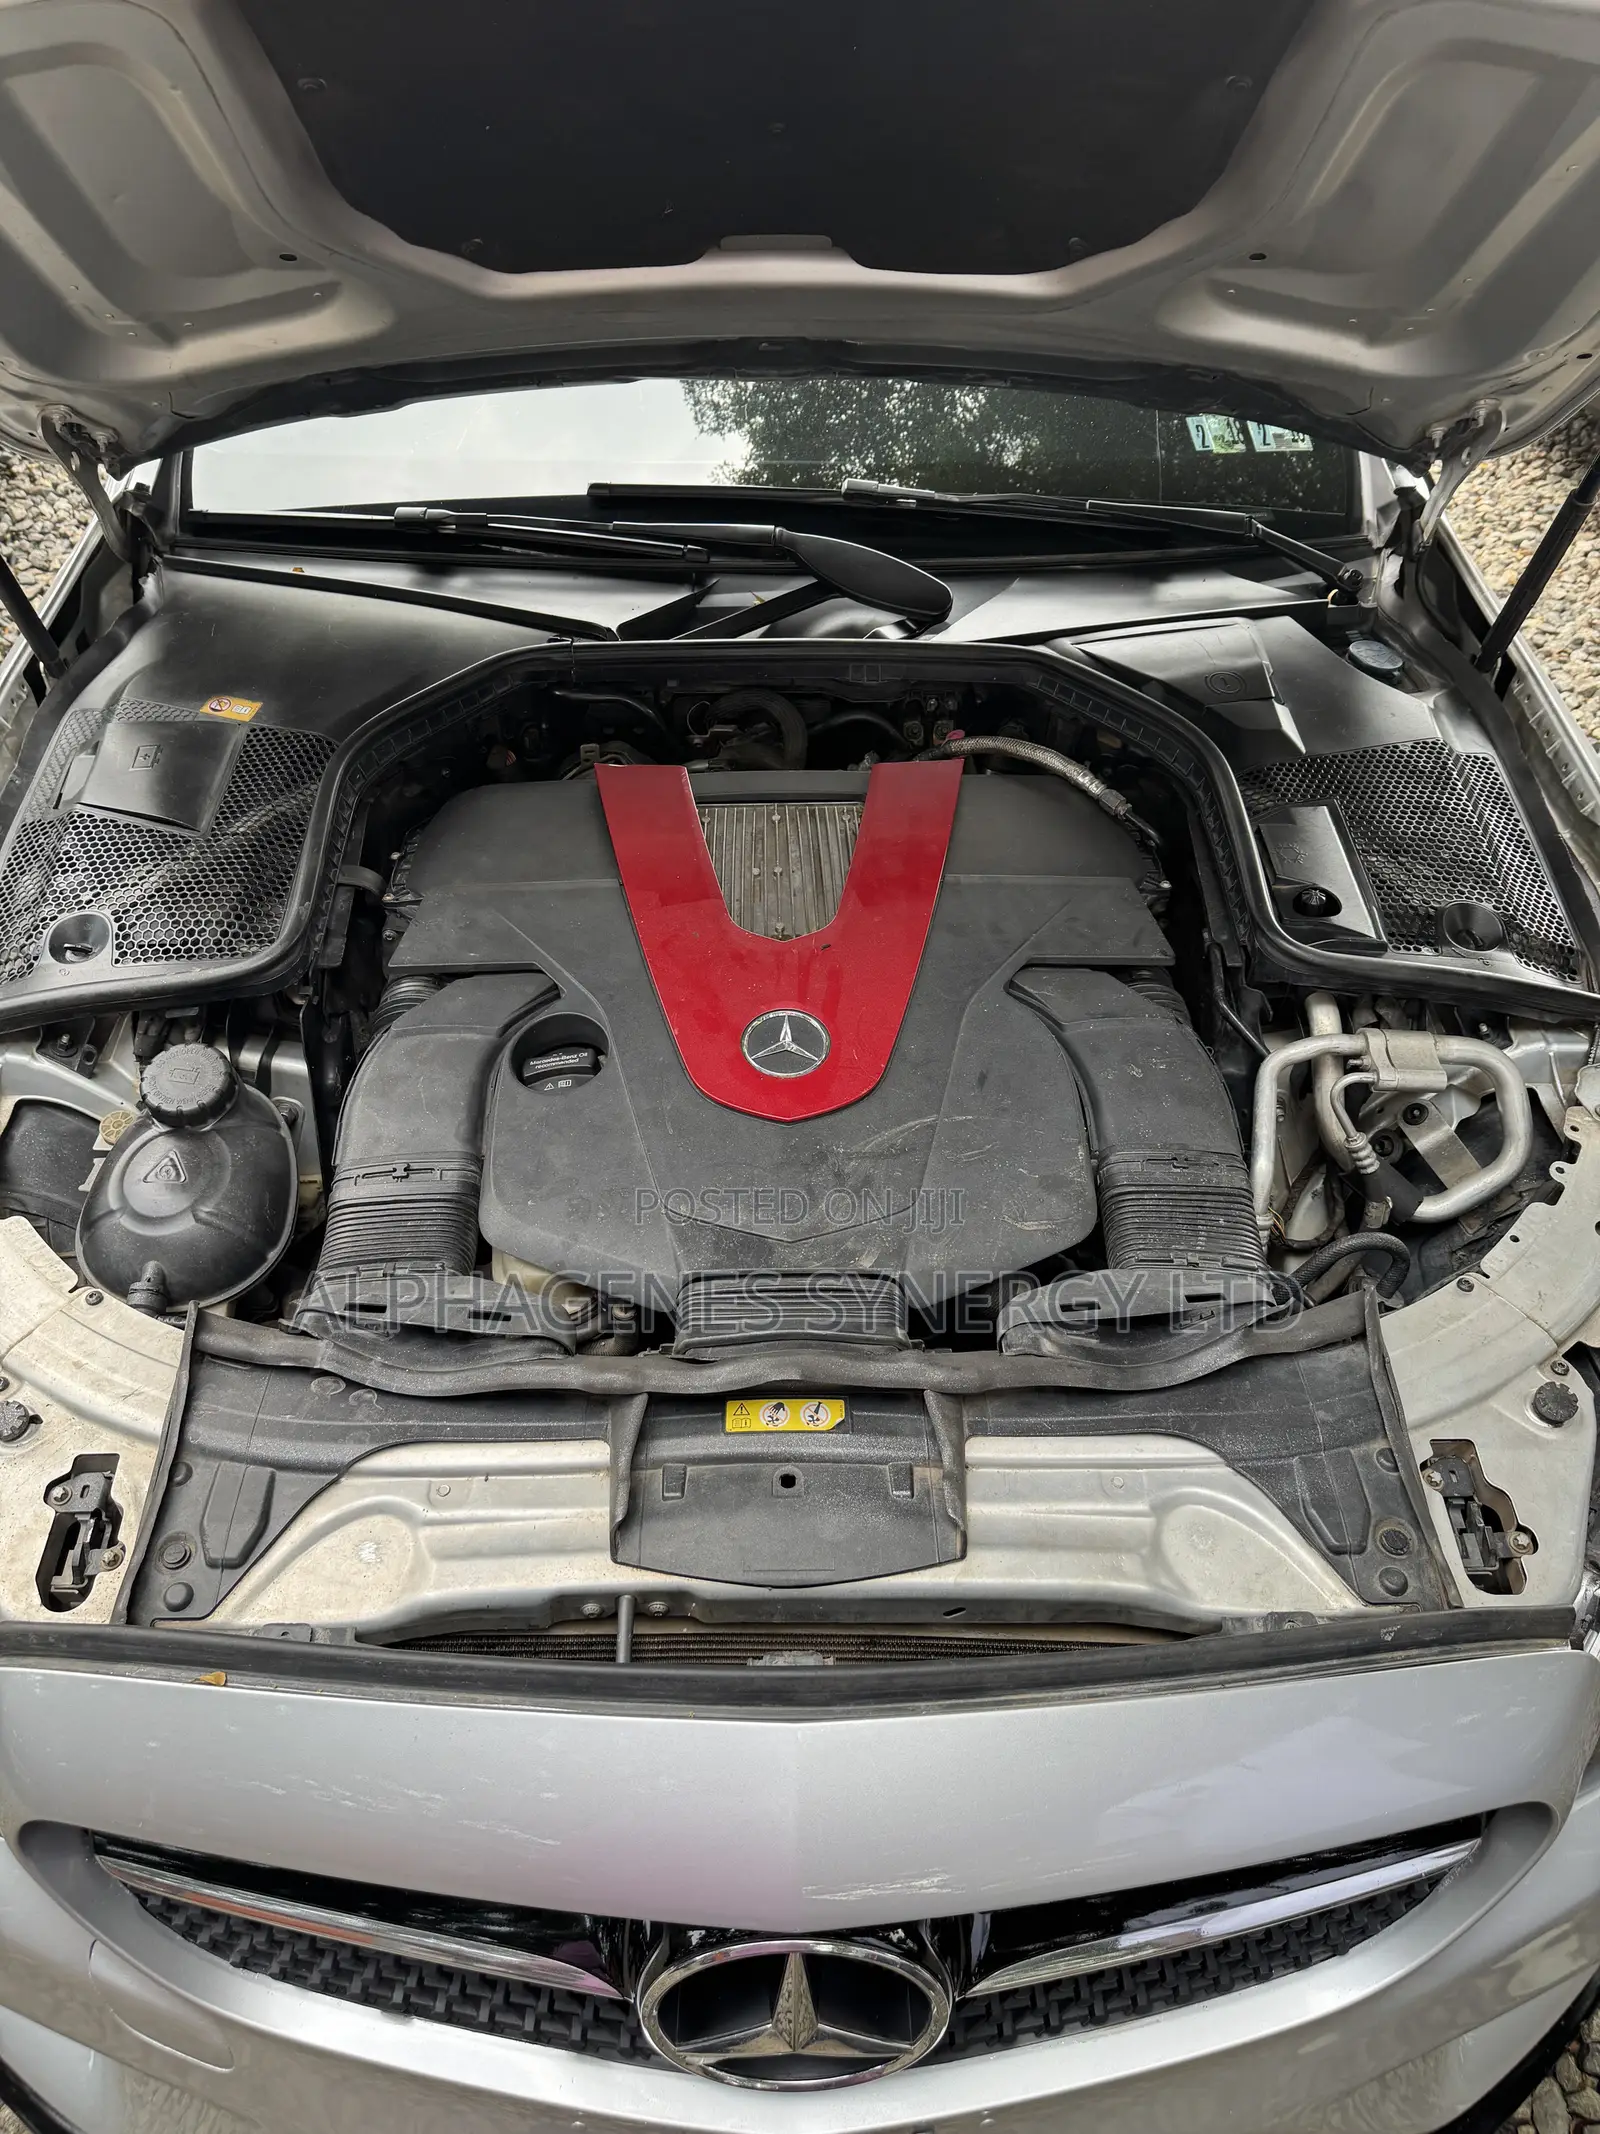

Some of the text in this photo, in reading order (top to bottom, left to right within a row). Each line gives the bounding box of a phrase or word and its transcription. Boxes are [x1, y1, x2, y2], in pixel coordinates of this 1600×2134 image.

[1195, 424, 1210, 449] 2
[529, 1054, 578, 1066] Mercedes-Benz
[535, 1057, 579, 1069] recommended
